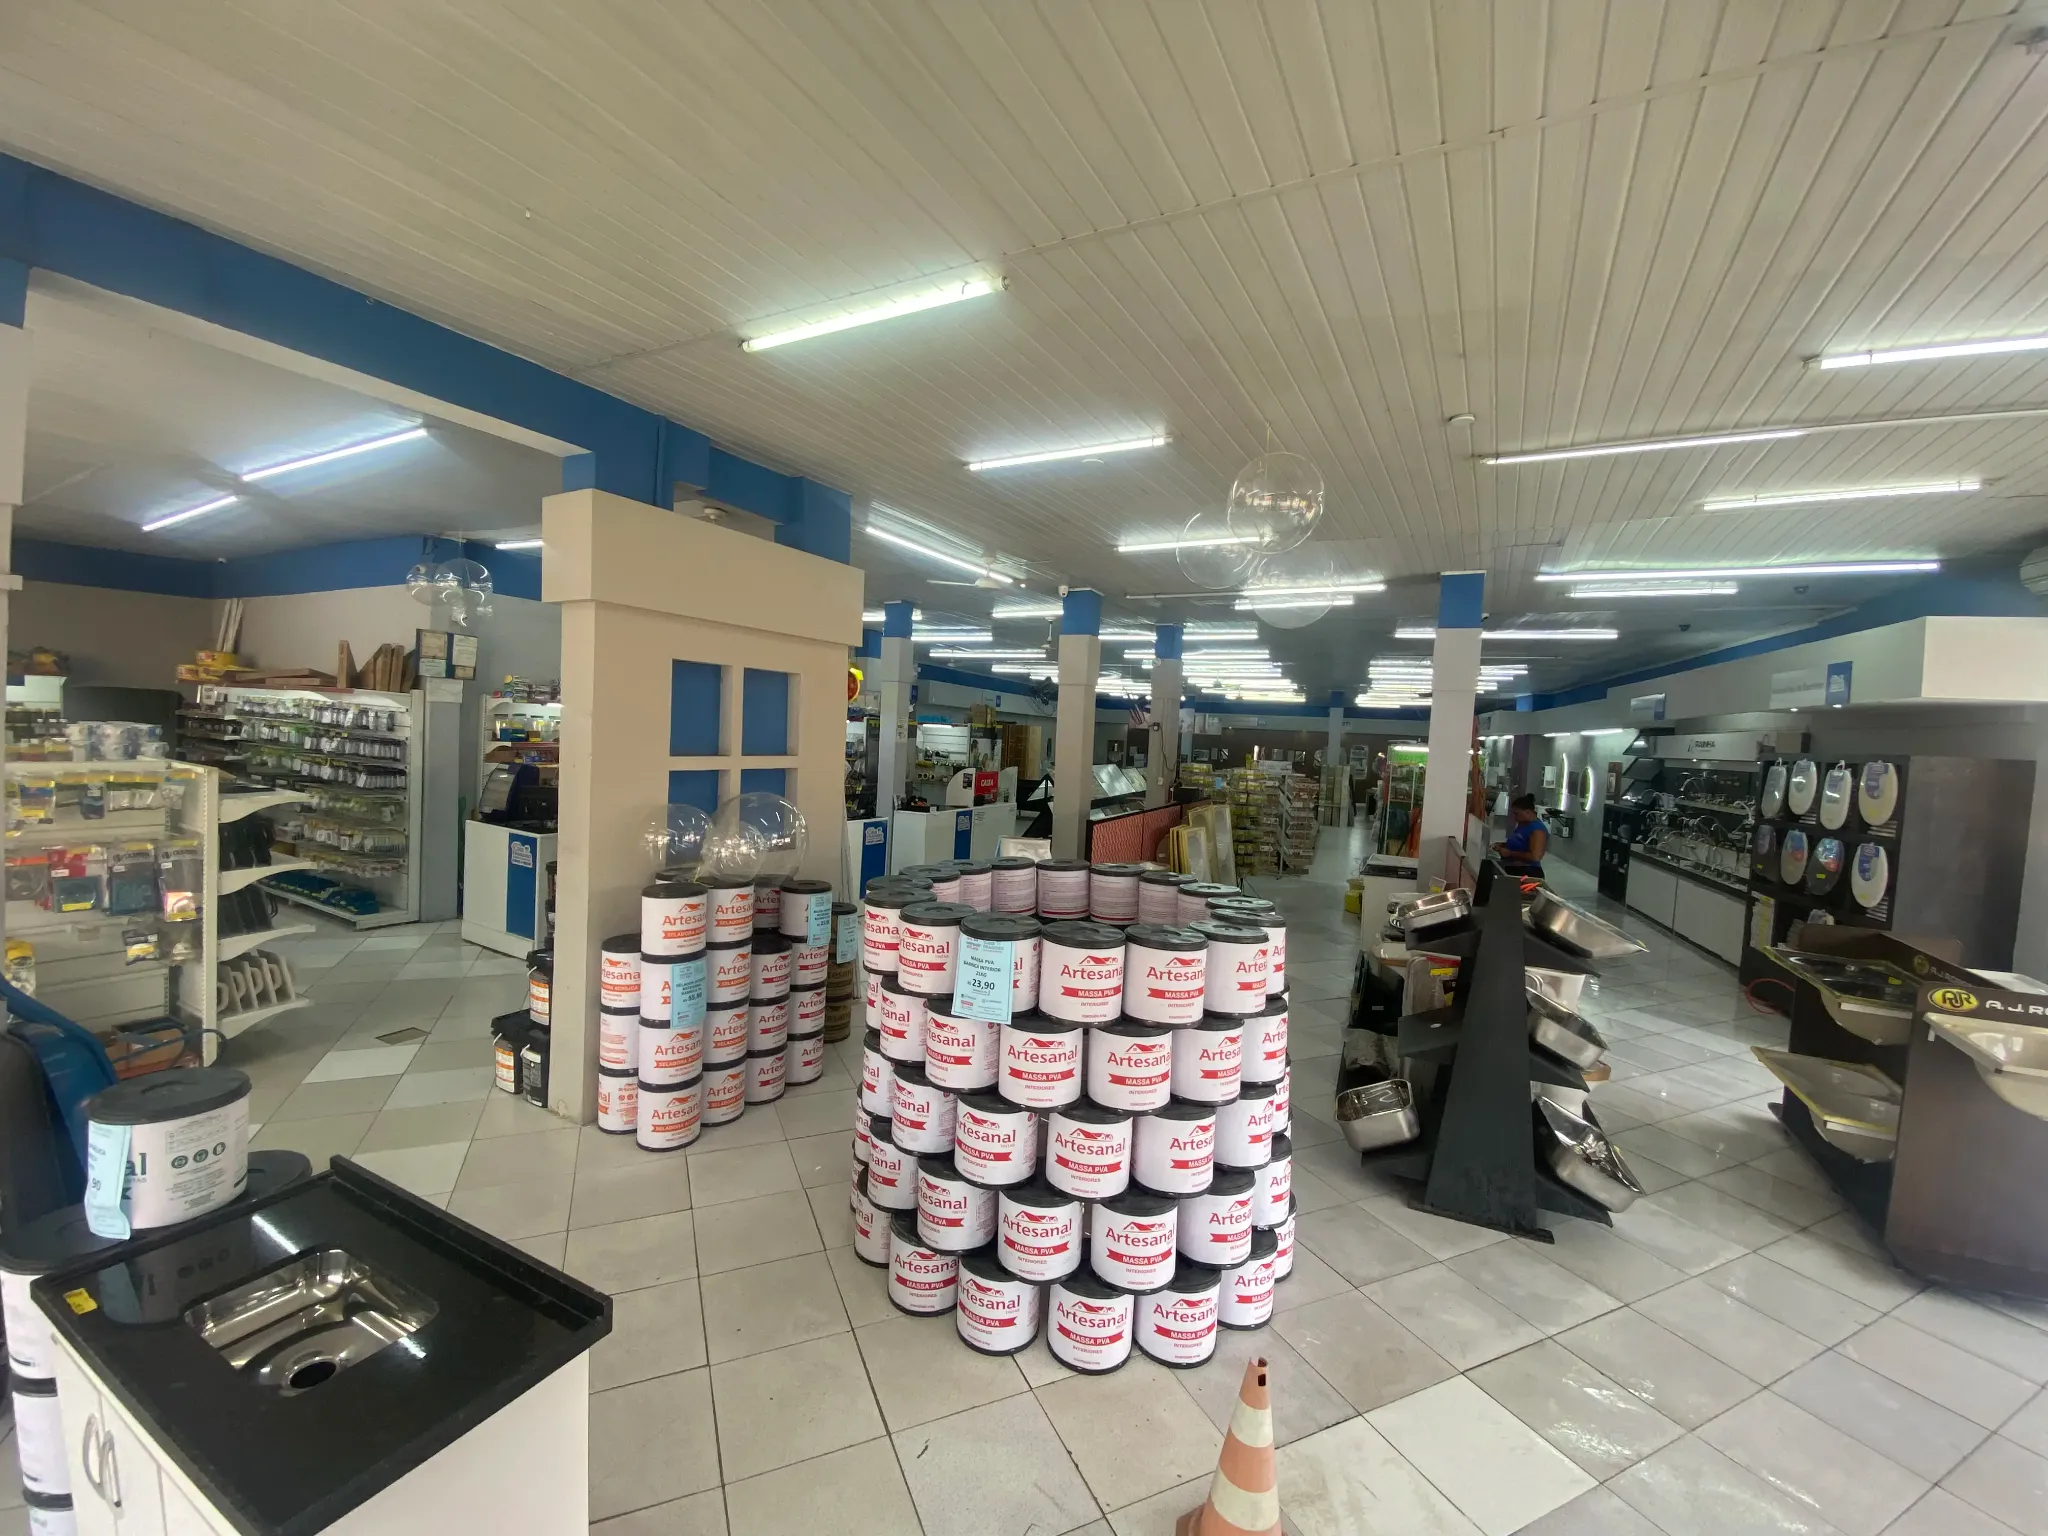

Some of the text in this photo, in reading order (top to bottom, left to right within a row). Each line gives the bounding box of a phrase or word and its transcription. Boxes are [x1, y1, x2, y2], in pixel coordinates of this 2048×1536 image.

[980, 964, 1001, 972] INTERIOR
[972, 978, 994, 990] 23,90
[1104, 989, 1114, 997] PVA
[1164, 990, 1188, 998] MASSA
[1008, 1044, 1078, 1064] Artesanal
[1022, 1072, 1046, 1080] MASSA
[1126, 1076, 1162, 1086] MASSA PVA
[902, 1118, 910, 1126] PVA
[957, 1120, 1016, 1144] rtesanal
[1055, 1132, 1126, 1156] Artesanal
[962, 1143, 994, 1160] MASSA PVA
[1068, 1162, 1092, 1172] MASSA
[934, 1218, 946, 1226] PVA
[1002, 1212, 1072, 1238] Artesanal
[1106, 1222, 1175, 1247] Artesanal
[1015, 1243, 1038, 1254] MASSA
[1122, 1256, 1162, 1265] MASSA PVA
[907, 1280, 930, 1290] MASSA
[965, 1308, 1000, 1326] MASSA PVA
[1056, 1301, 1128, 1328] Artesanal
[1070, 1332, 1095, 1344] MASSA
[1170, 1328, 1208, 1340] MASSA PVA
